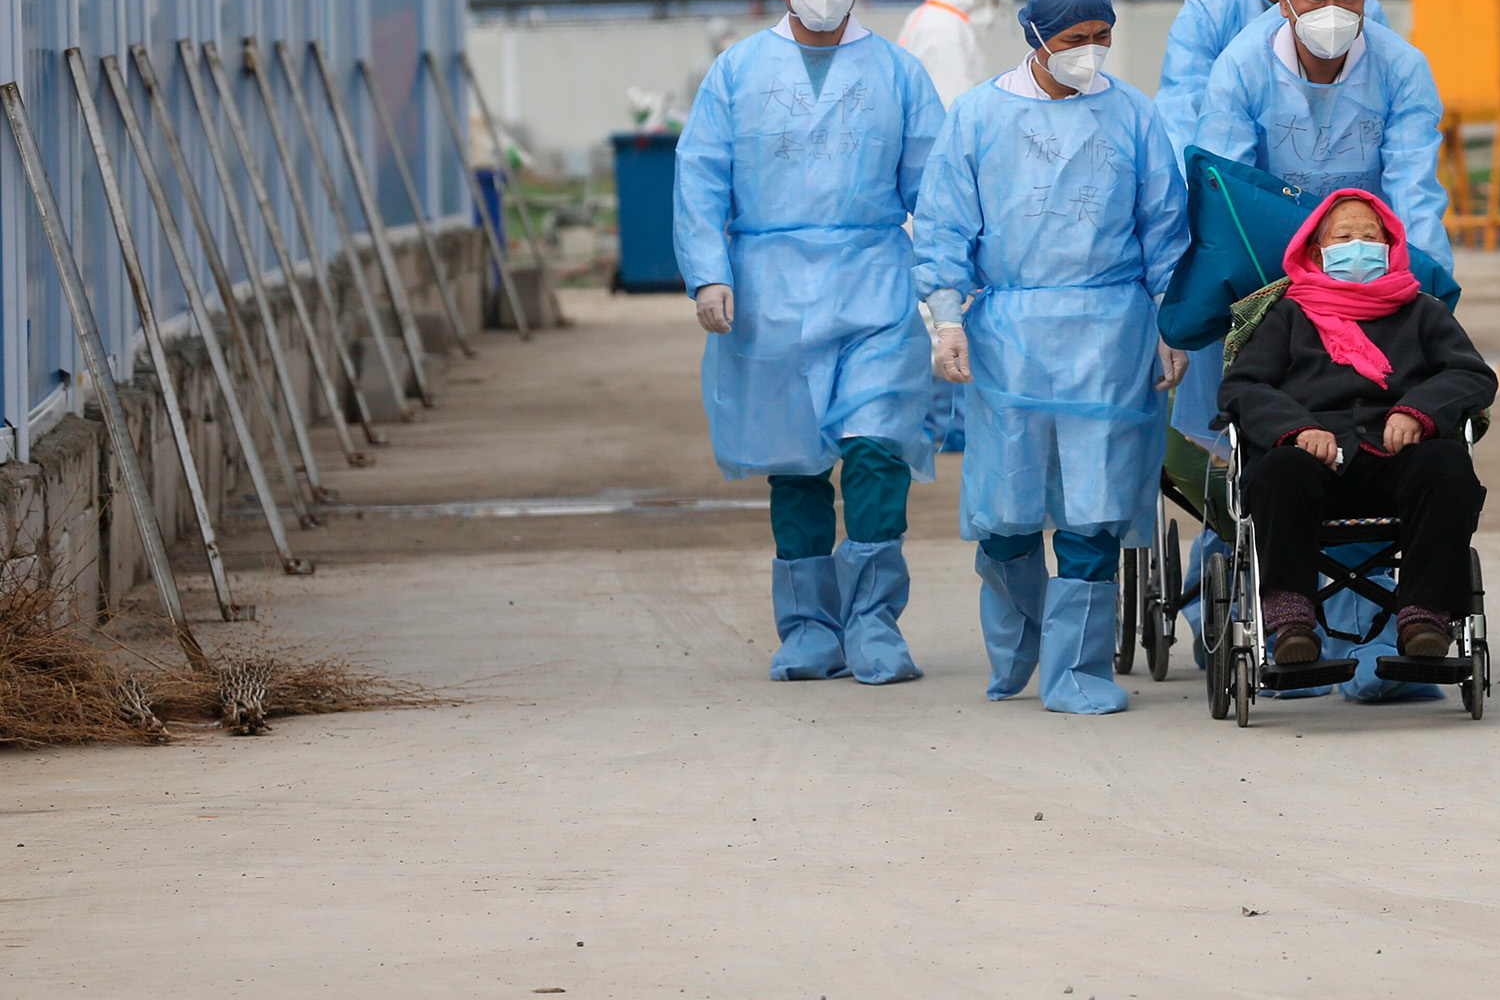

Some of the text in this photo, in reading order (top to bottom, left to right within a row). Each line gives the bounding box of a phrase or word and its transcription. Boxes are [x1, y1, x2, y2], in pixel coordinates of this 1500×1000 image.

[760, 80, 875, 124] 大医二院
[1022, 128, 1119, 180] 旅顺
[1272, 114, 1383, 163] 大医二院
